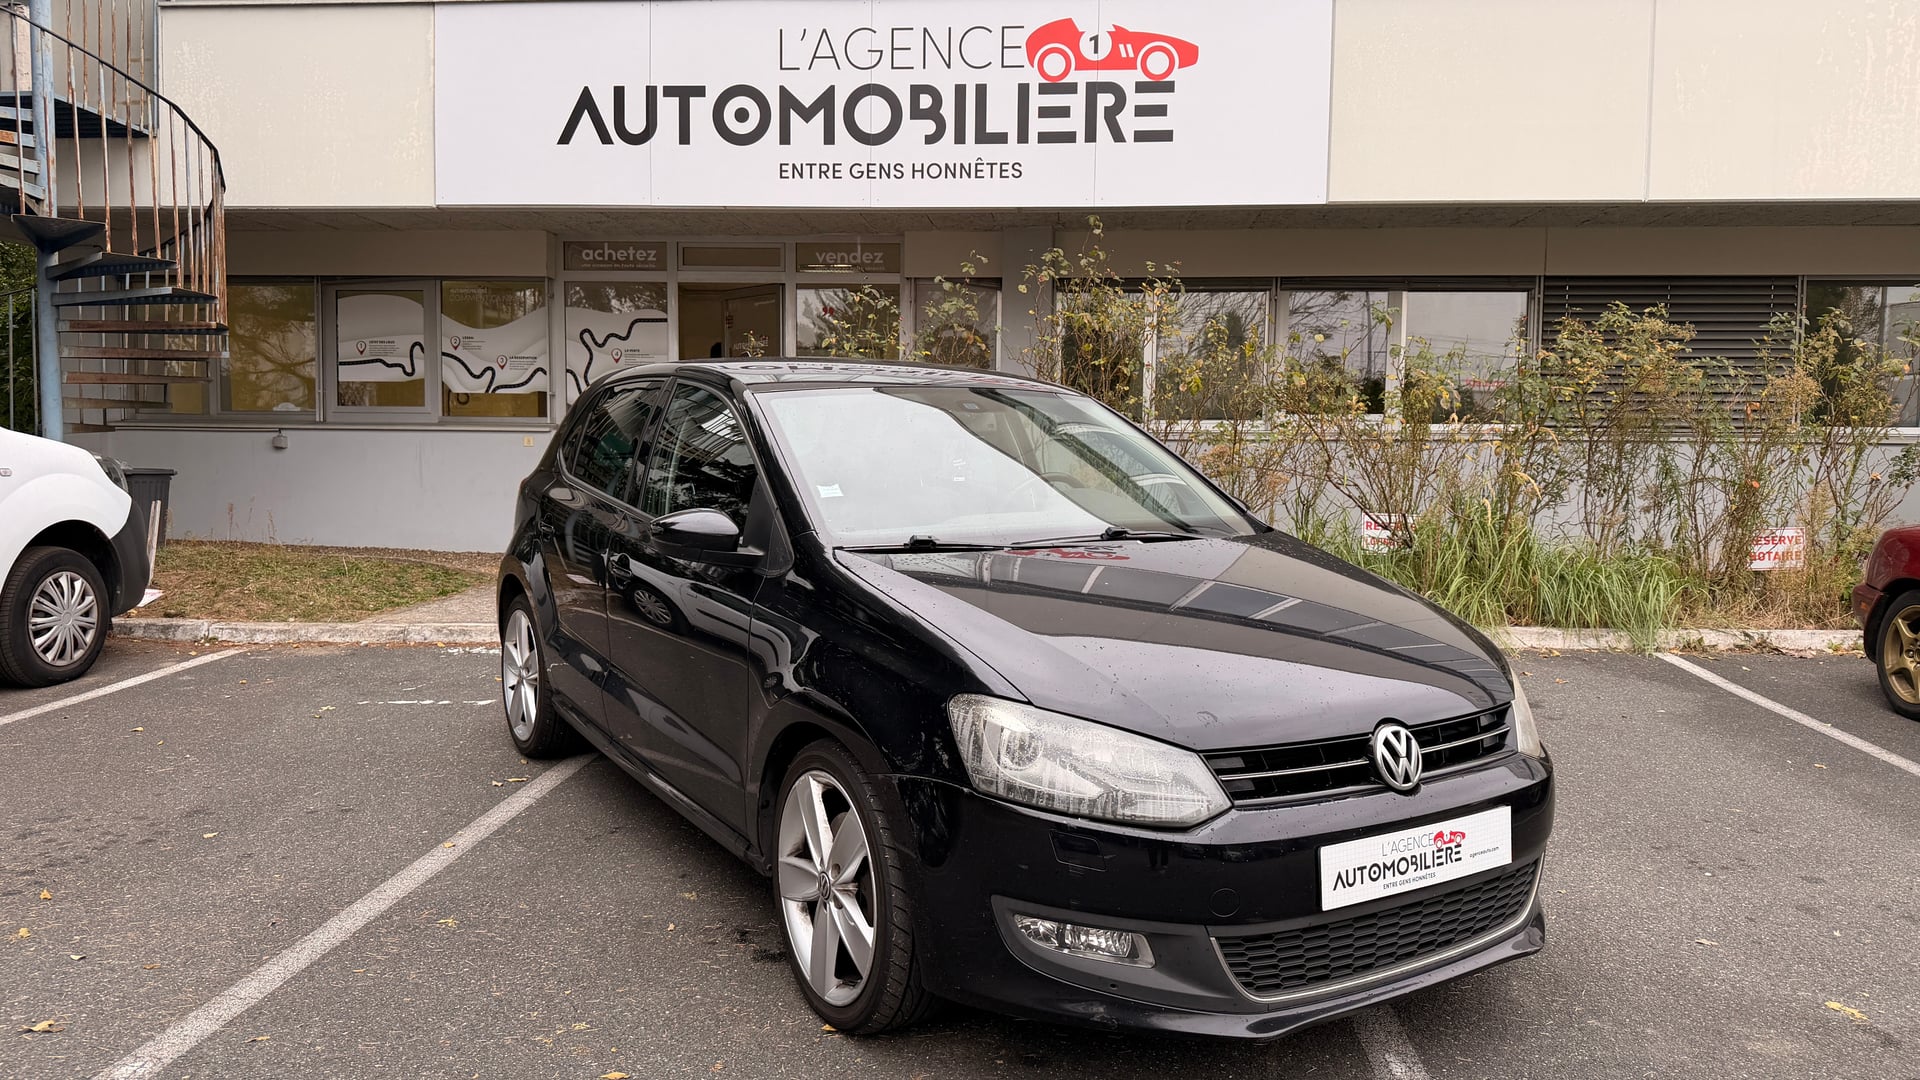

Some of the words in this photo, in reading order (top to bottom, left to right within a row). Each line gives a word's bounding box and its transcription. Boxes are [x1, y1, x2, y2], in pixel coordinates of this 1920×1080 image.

[778, 25, 1026, 71] L'AGENCE
[1089, 34, 1099, 54] 1
[778, 161, 843, 179] ENTRE
[849, 161, 905, 179] GENS
[911, 157, 1023, 179] HONNÊTES
[582, 242, 657, 261] achetez
[816, 243, 884, 264] vendez
[1381, 832, 1434, 857] L'AGENCE
[1383, 880, 1398, 890] ENTRE
[1399, 877, 1411, 886] GENS
